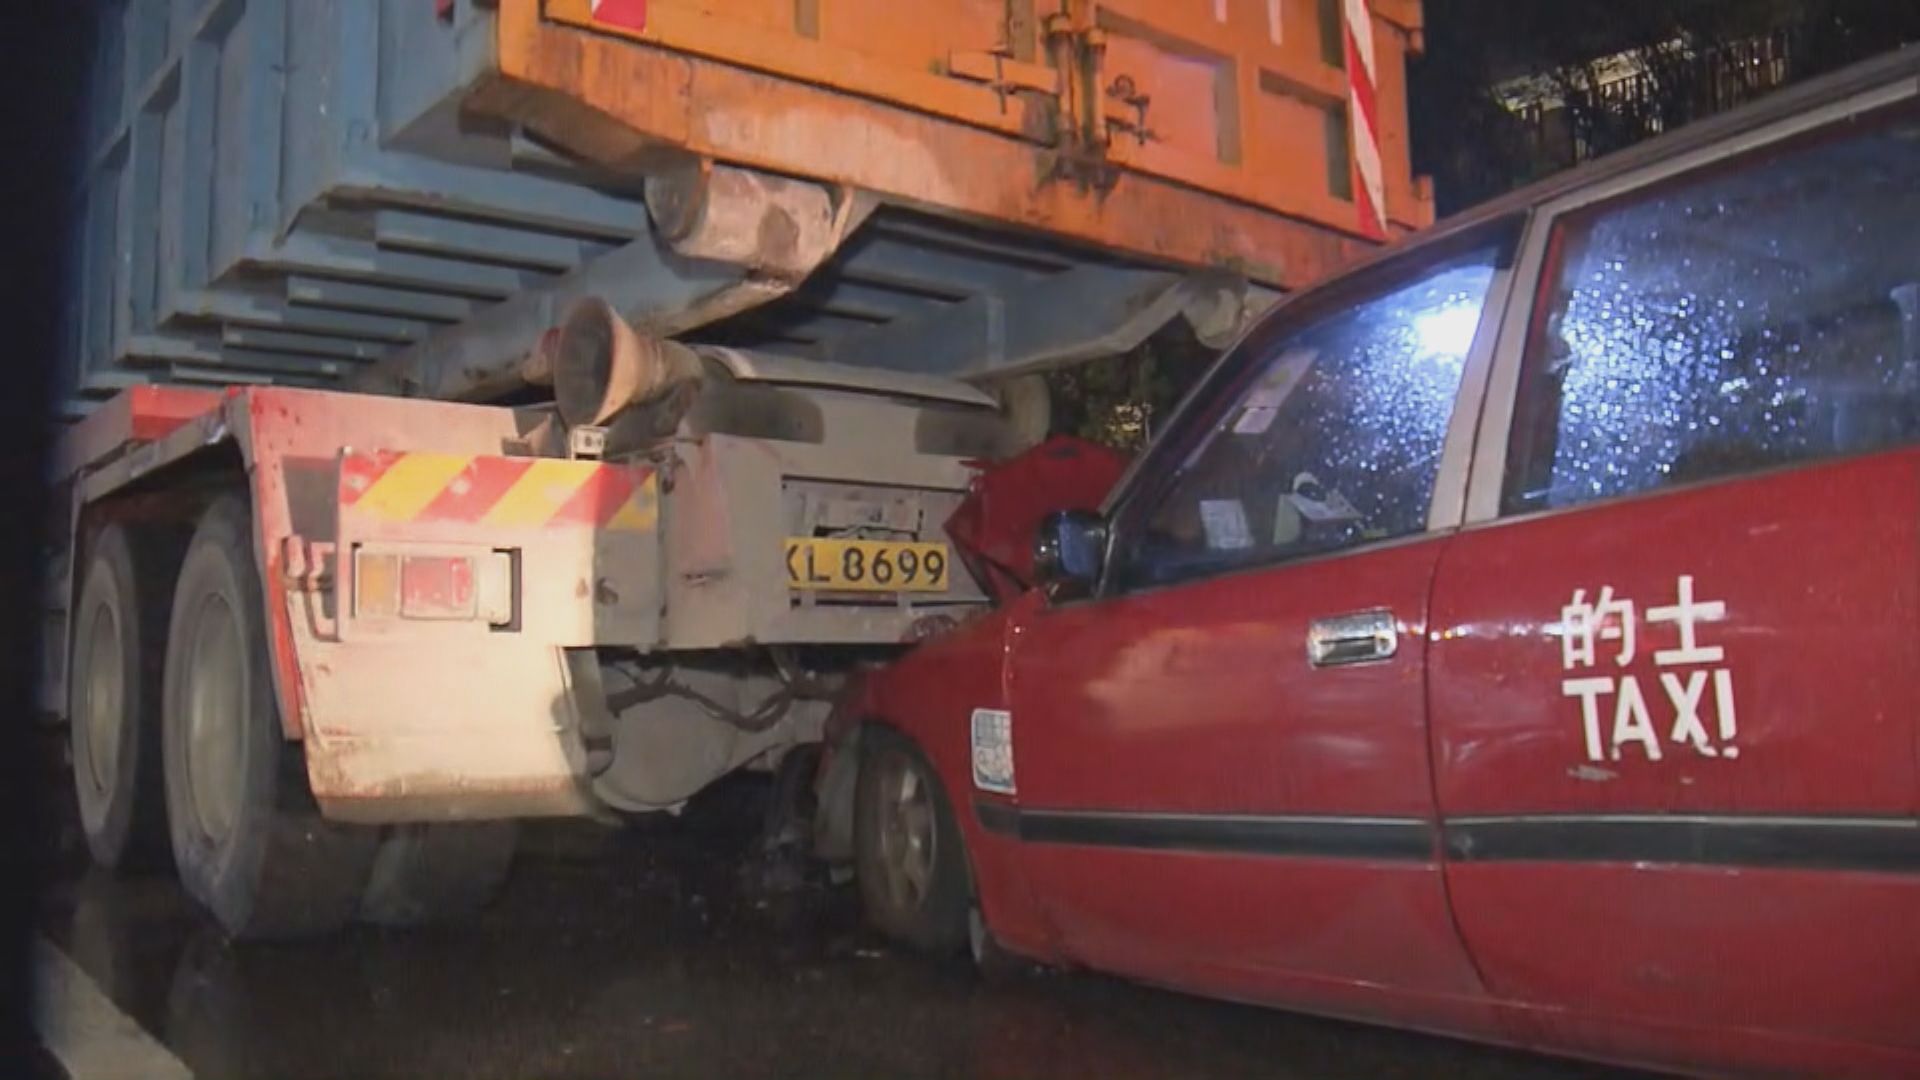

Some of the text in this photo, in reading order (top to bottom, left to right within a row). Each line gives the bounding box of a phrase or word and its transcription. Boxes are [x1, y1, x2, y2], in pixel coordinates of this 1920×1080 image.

[843, 547, 944, 584] 8699
[1562, 575, 1725, 669] 的士
[1562, 668, 1739, 761] TAXI
